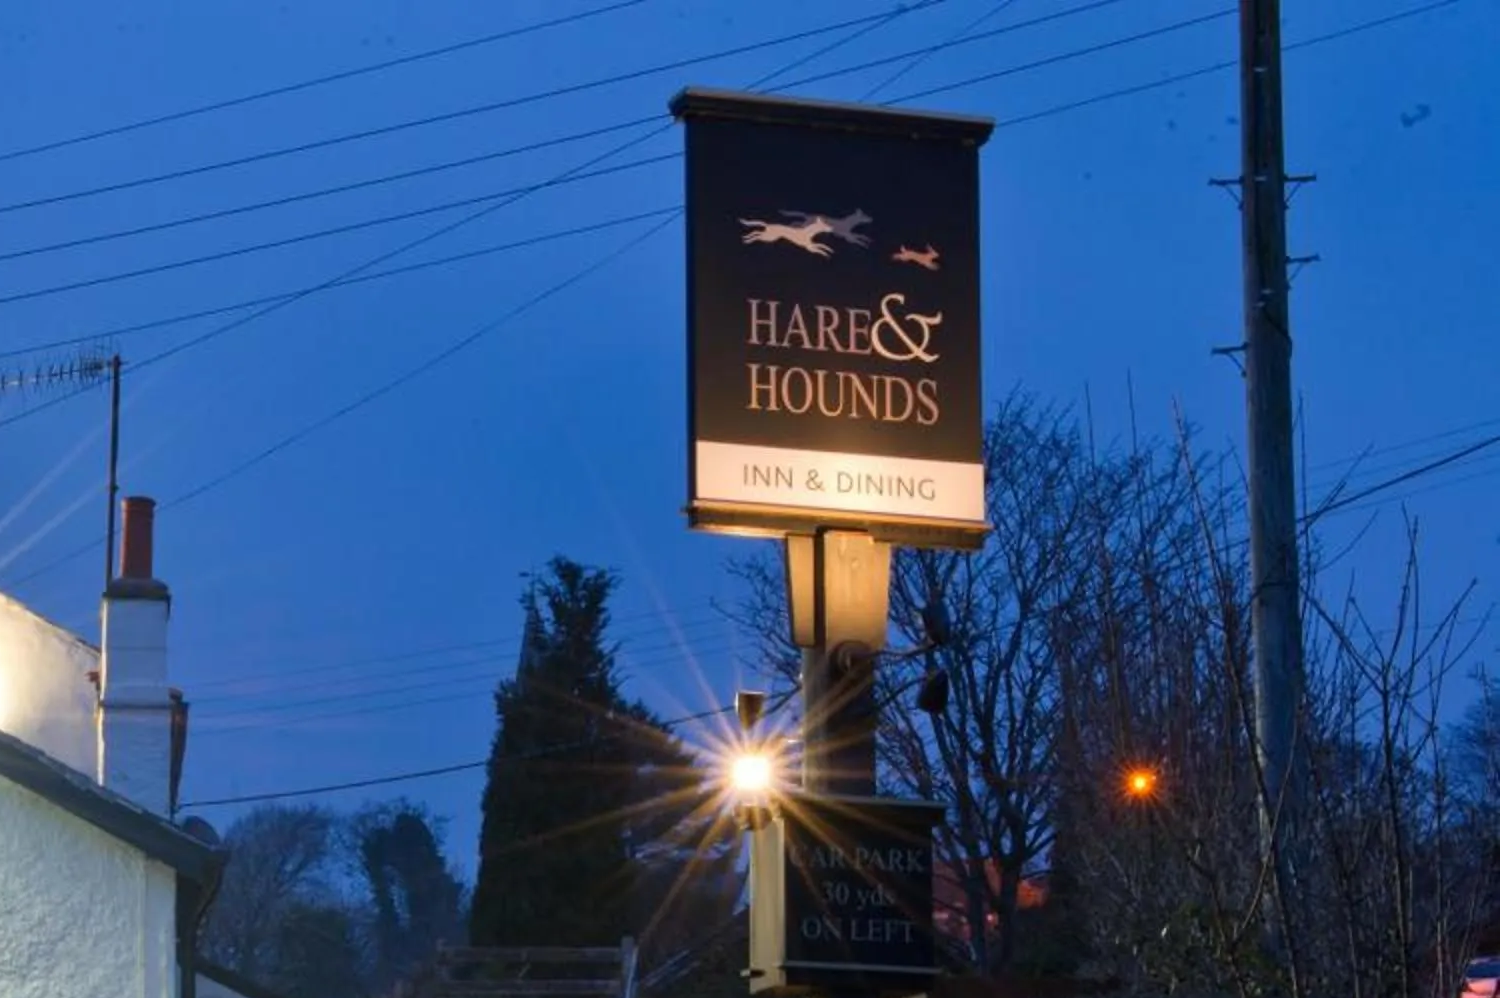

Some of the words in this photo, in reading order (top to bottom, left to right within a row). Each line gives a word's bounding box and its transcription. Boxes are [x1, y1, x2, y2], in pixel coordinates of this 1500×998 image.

[746, 363, 939, 427] HOUNDS
[743, 463, 794, 490] INN
[805, 467, 825, 492] &
[837, 470, 937, 502] DINING
[855, 847, 925, 872] PARK
[801, 915, 843, 941] ON
[850, 918, 916, 945] LEFT
